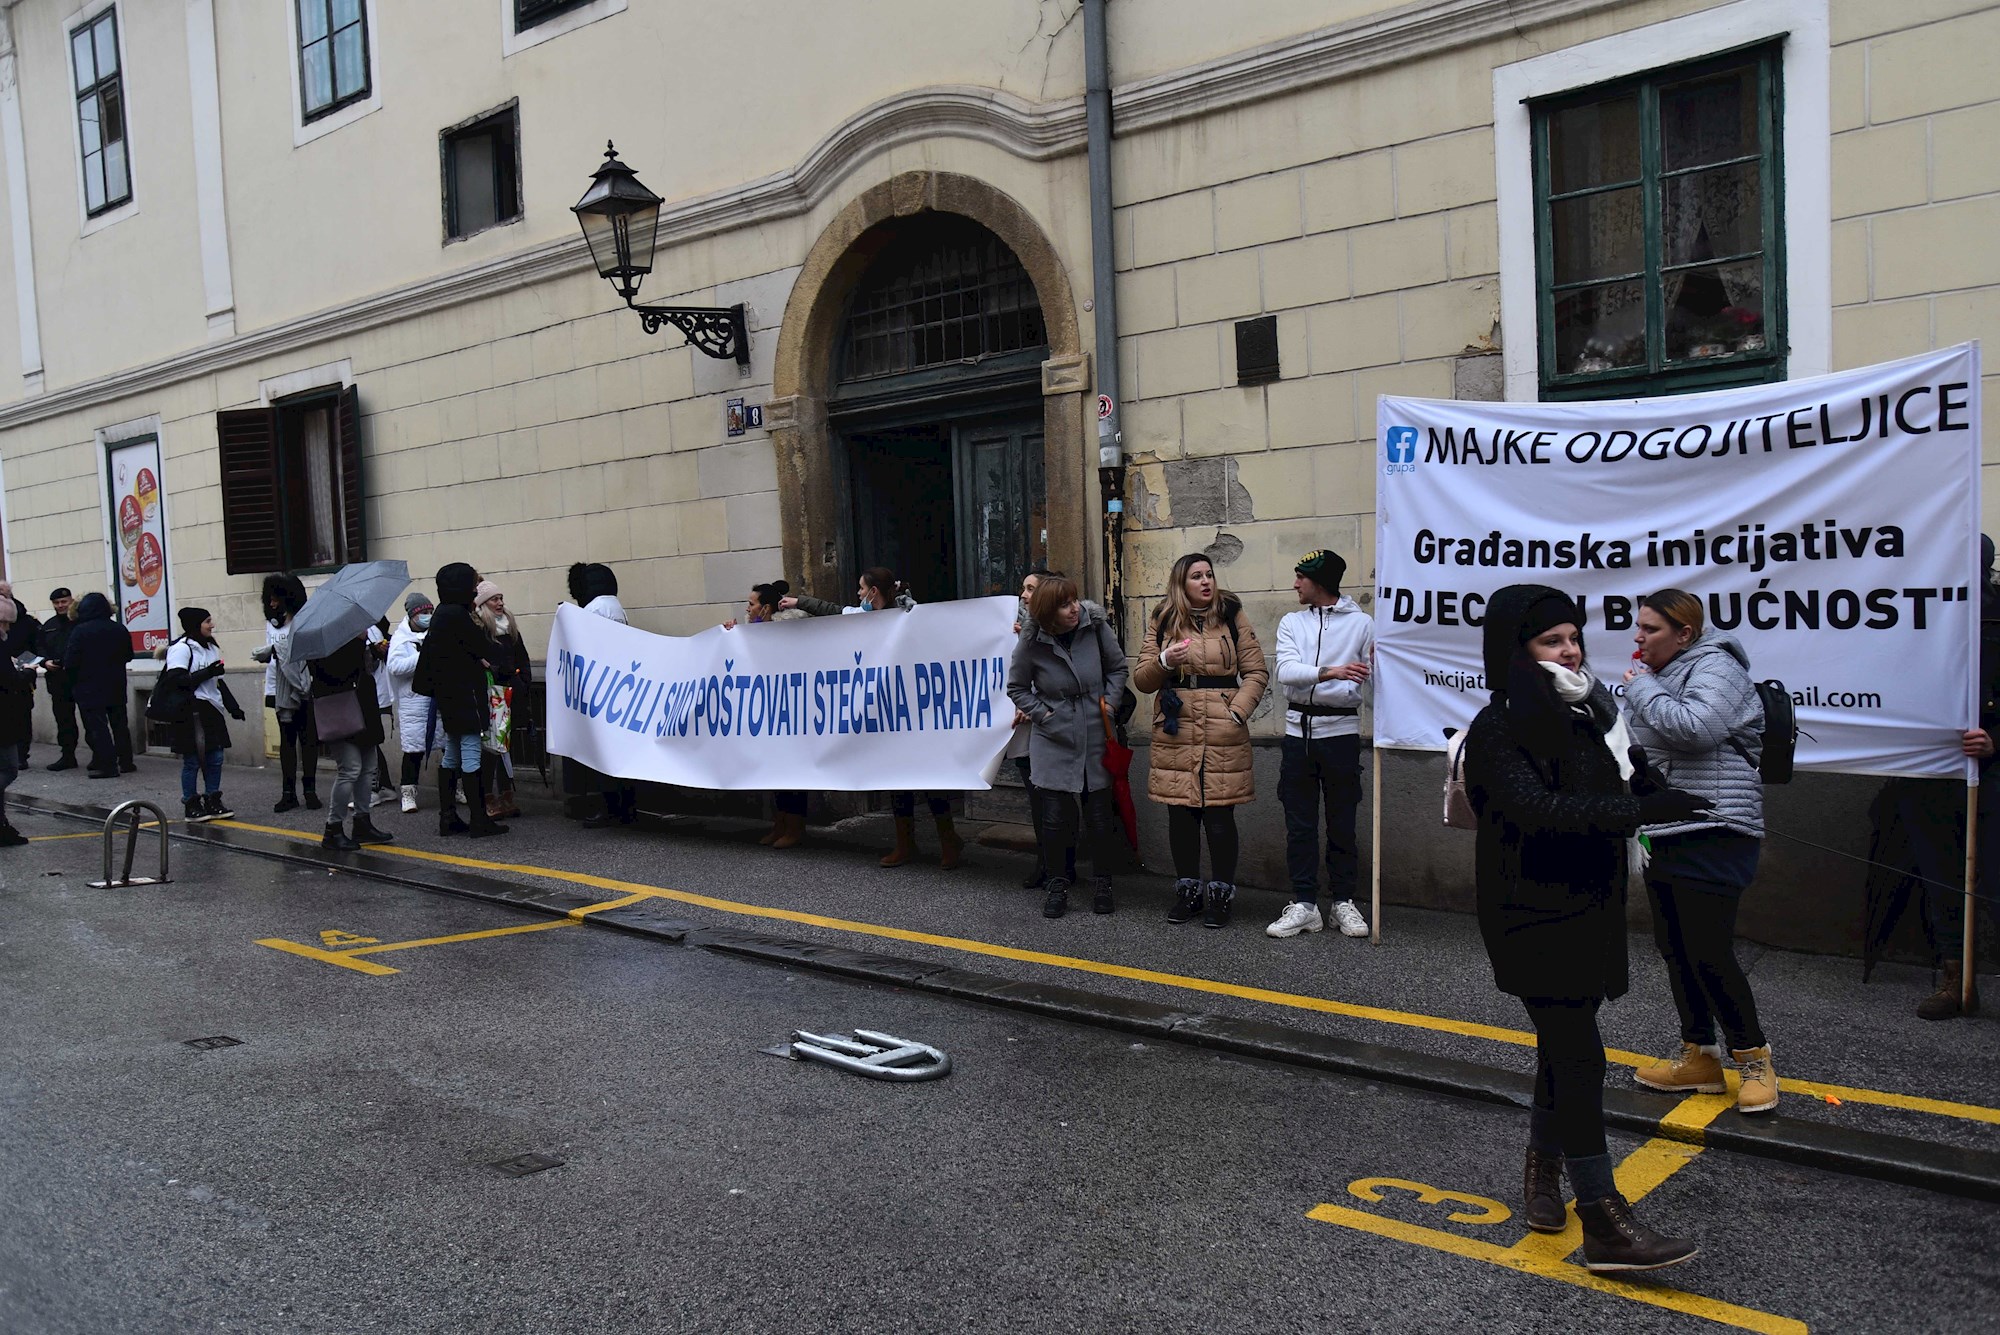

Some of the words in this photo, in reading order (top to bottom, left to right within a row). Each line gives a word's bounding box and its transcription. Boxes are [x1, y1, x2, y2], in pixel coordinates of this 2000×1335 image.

[752, 407, 759, 425] 8
[1424, 427, 1558, 465] MAJKE
[1565, 382, 1969, 464] ODGOJITELJICE
[1386, 463, 1415, 475] grupa
[1413, 529, 1631, 569] Građanska
[1647, 519, 1905, 572] inicijativa
[1378, 586, 1486, 627] "DJEC
[1603, 578, 1968, 630] BUĆNOST"
[656, 679, 696, 737] SMO
[694, 658, 807, 737] POŠTOVATI
[813, 650, 912, 735] STEČENA
[1347, 1177, 1512, 1225] 3
